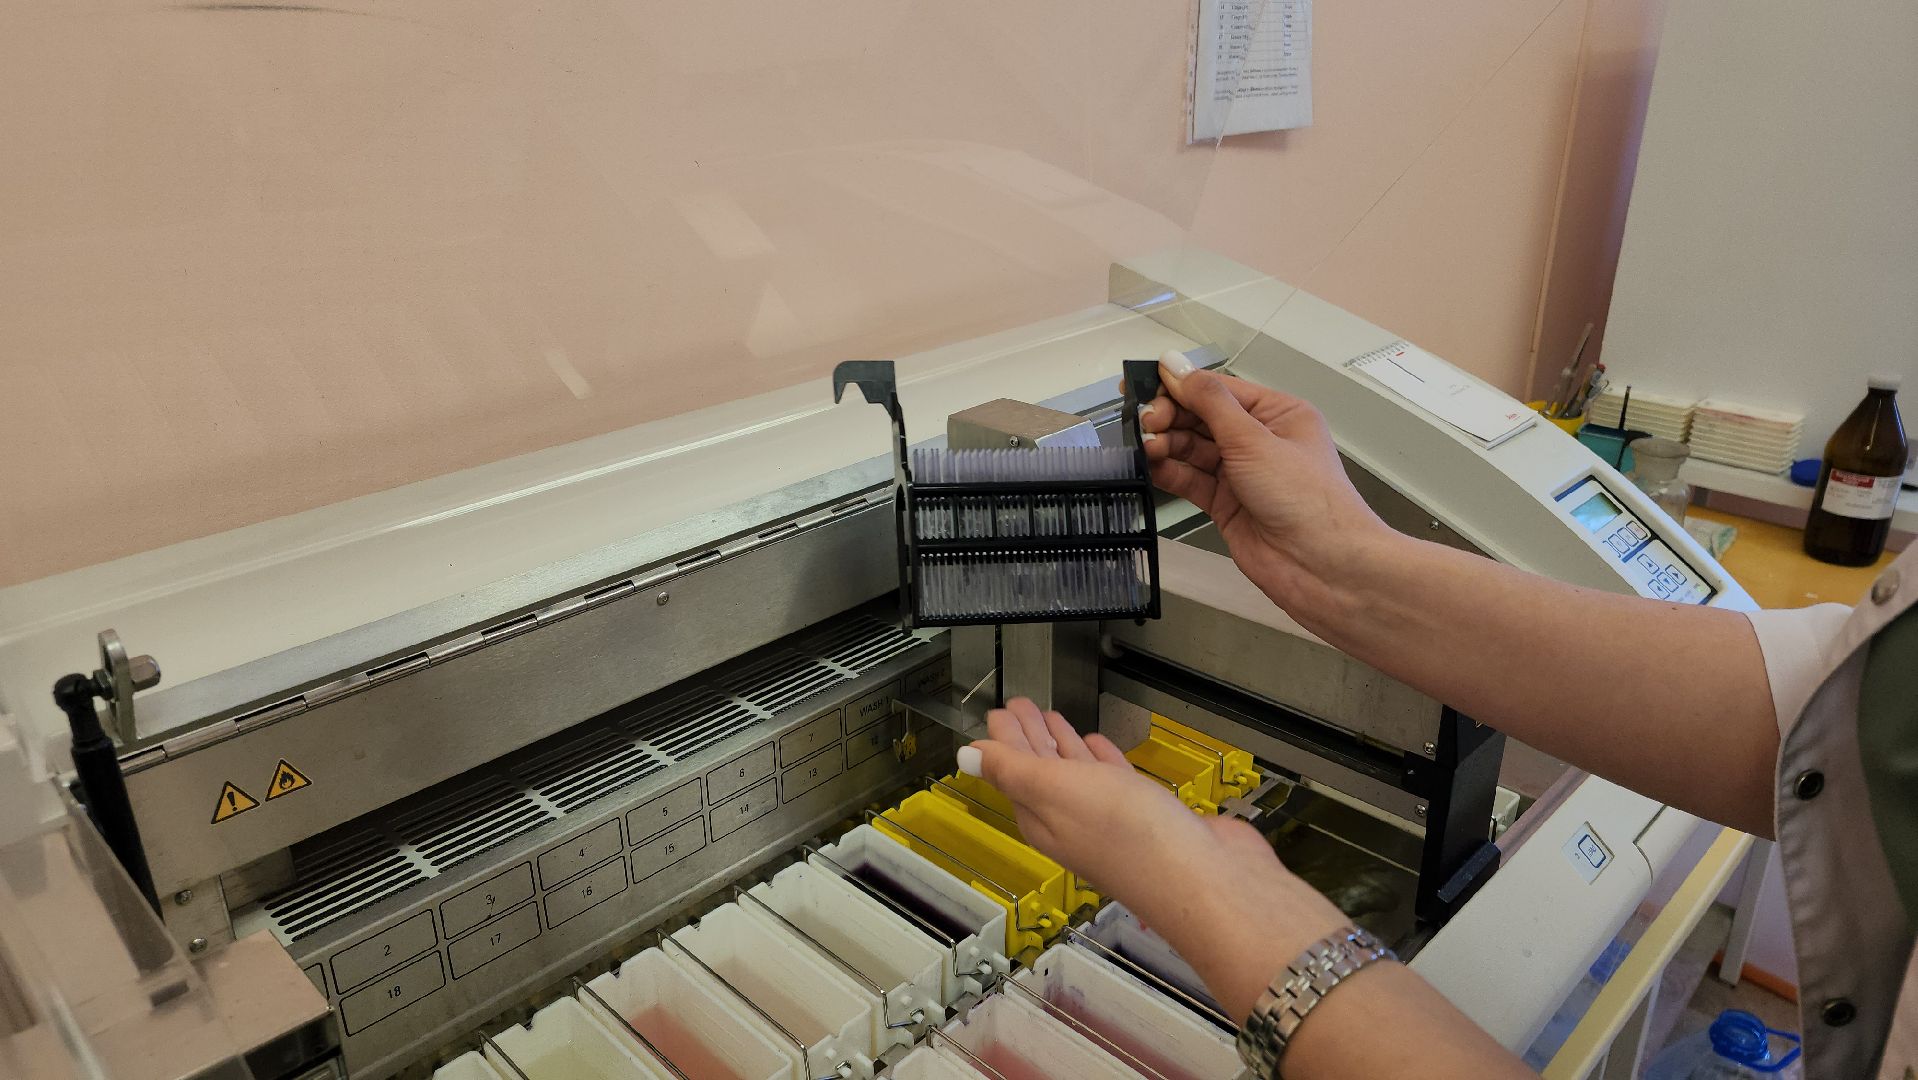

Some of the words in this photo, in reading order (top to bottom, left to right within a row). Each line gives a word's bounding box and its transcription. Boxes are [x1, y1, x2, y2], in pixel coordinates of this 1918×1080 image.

[859, 699, 882, 717] WASH
[808, 732, 814, 742] 7
[738, 768, 745, 778] 6
[808, 767, 818, 779] 13
[661, 806, 668, 817] 5
[739, 803, 750, 815] 14
[578, 848, 585, 858] 4
[664, 843, 675, 855] 15
[581, 886, 593, 899] 16
[490, 933, 501, 946] 17
[383, 944, 392, 957] 2
[387, 985, 402, 999] 18
